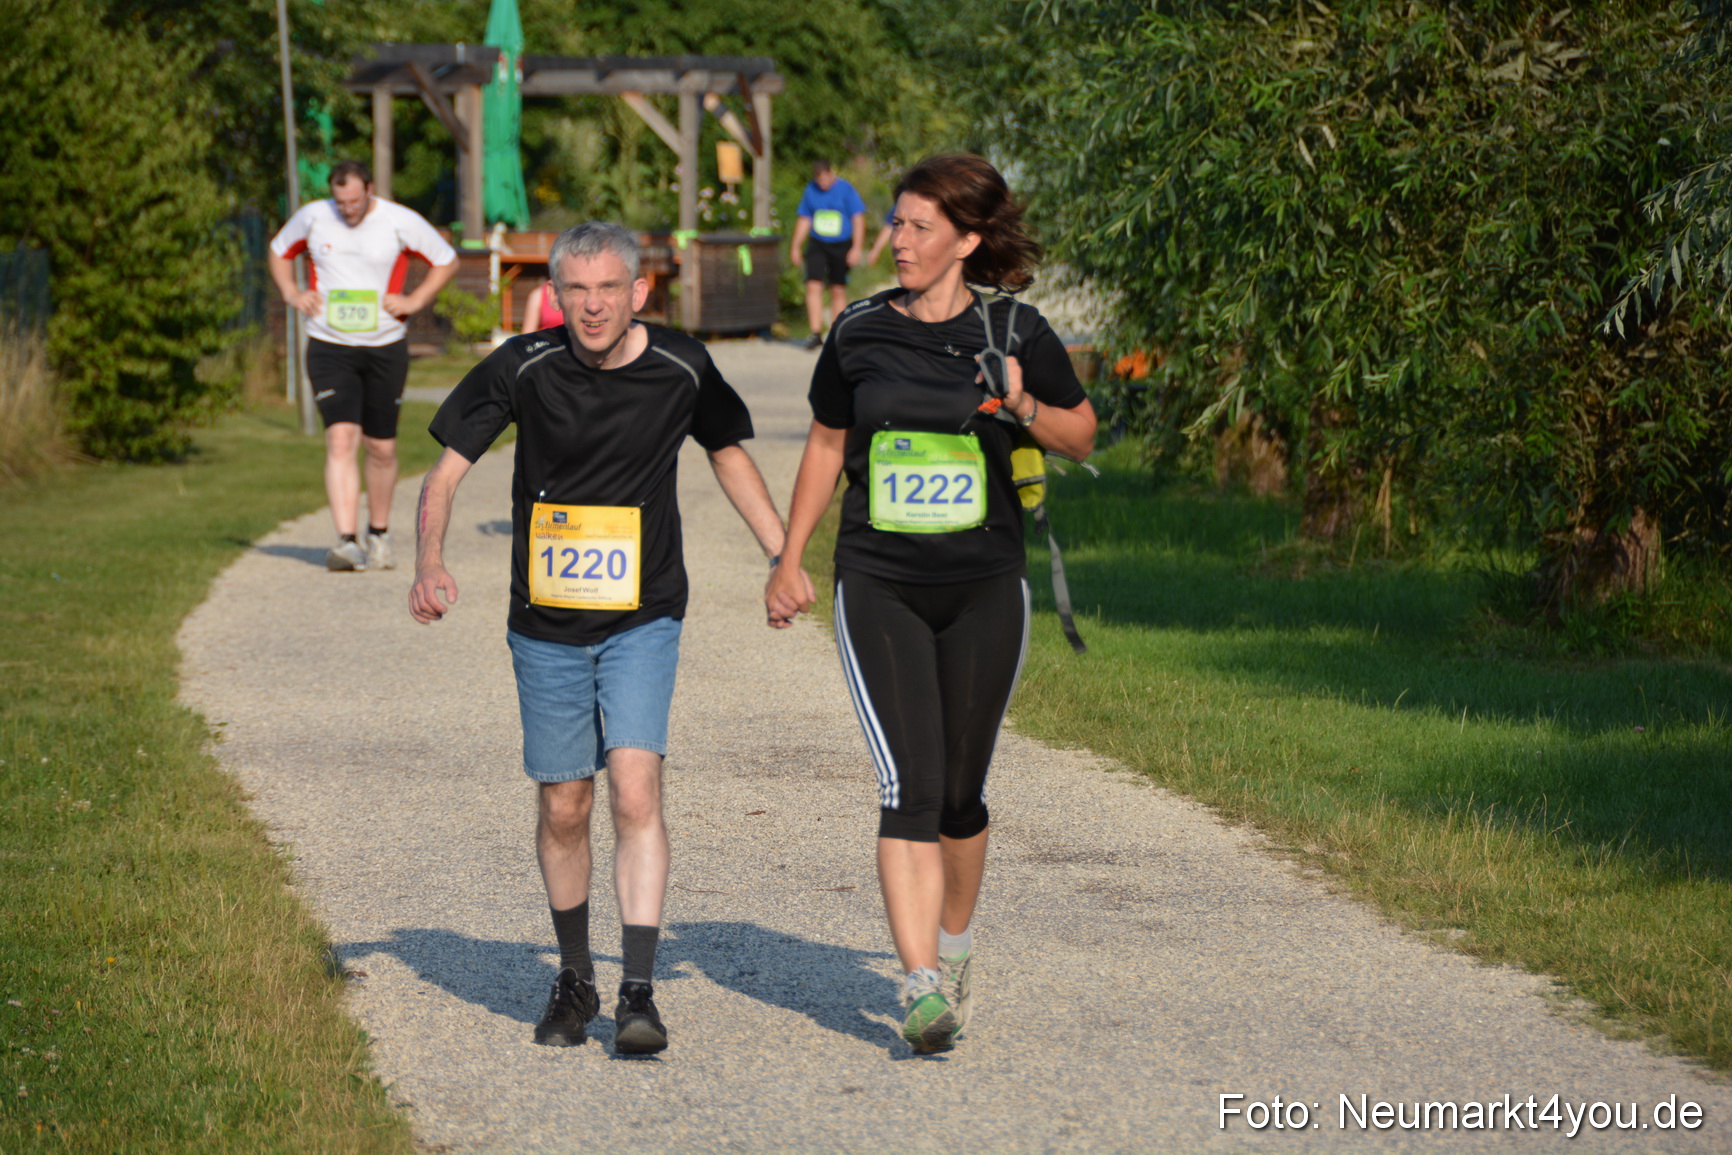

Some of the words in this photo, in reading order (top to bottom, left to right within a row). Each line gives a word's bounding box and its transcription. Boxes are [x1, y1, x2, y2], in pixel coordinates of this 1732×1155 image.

[337, 305, 368, 321] 570
[882, 472, 973, 504] 1222
[541, 546, 627, 580] 1220
[583, 586, 599, 594] Wolf
